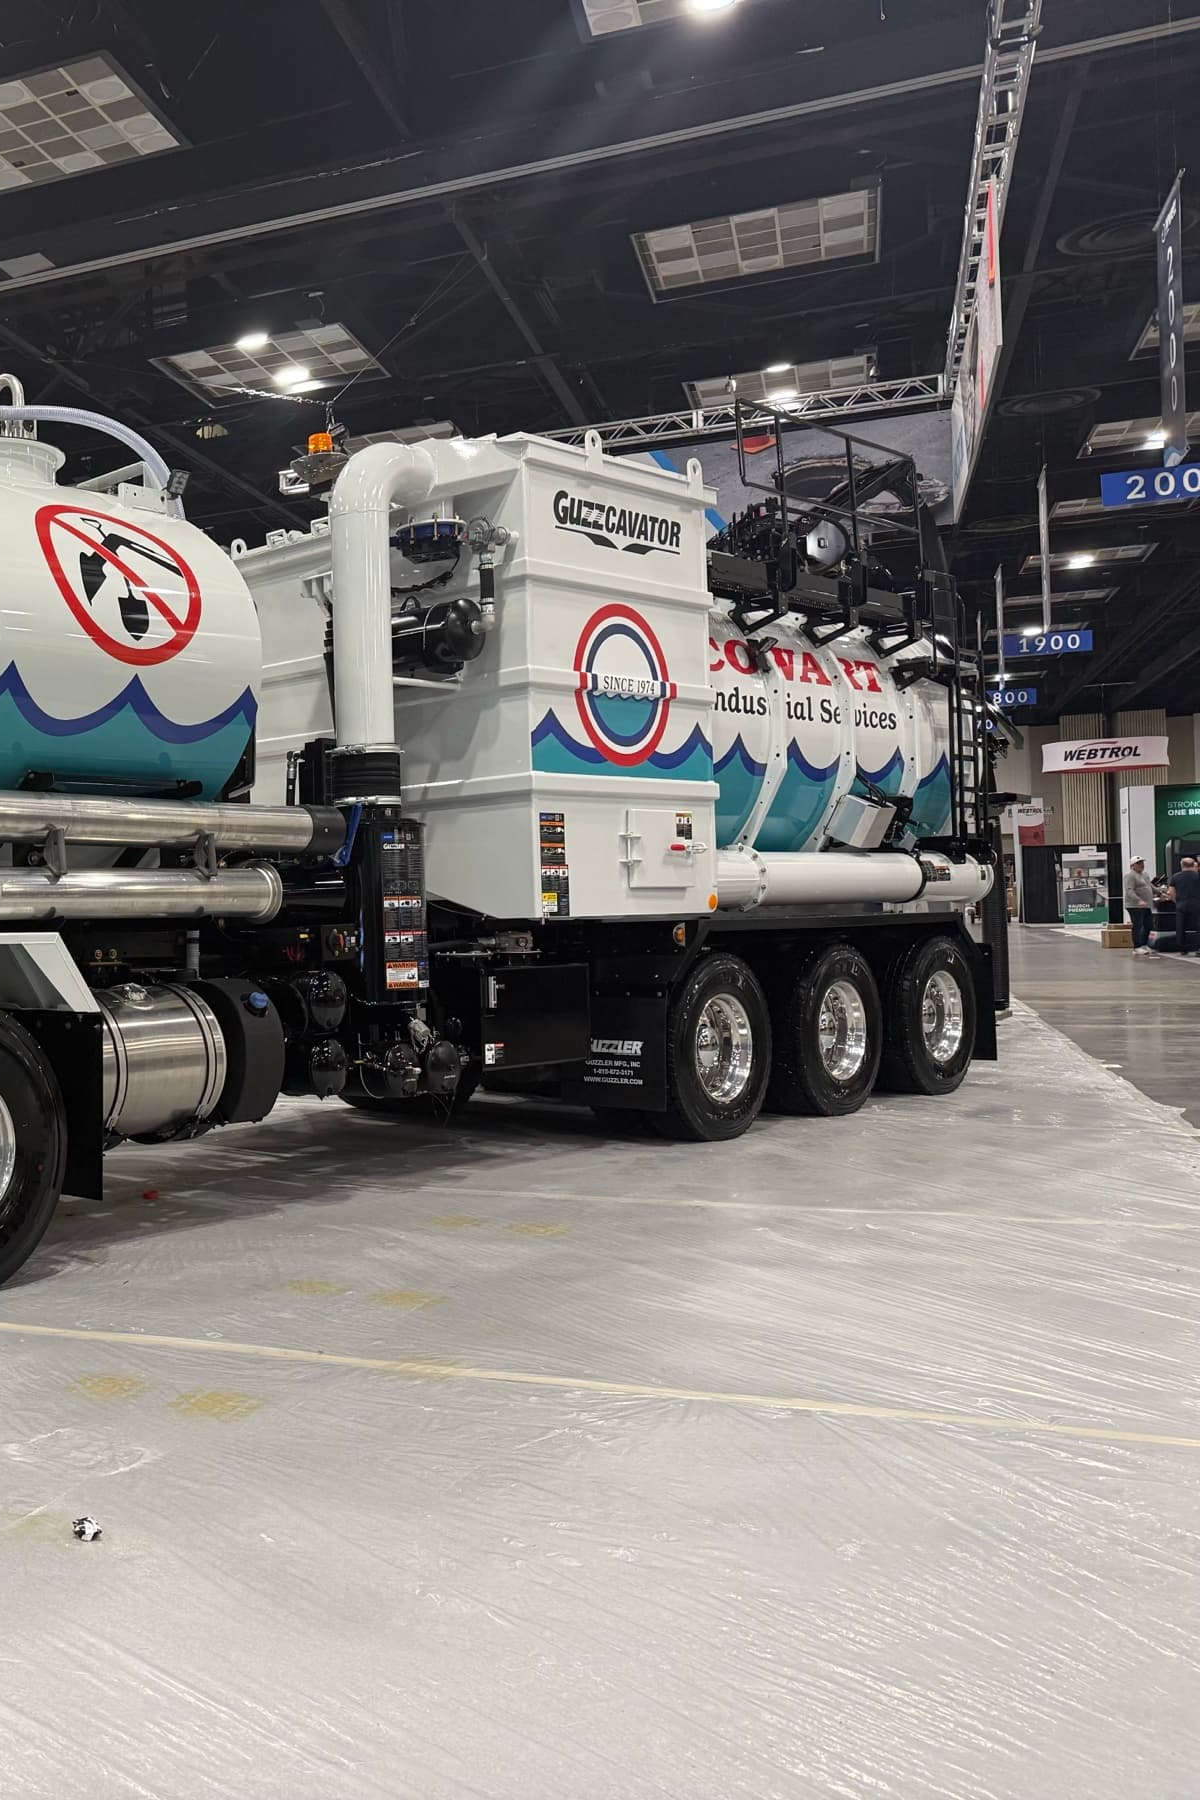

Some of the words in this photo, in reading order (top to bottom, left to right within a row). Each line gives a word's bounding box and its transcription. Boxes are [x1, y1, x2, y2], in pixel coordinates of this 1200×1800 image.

[1019, 633, 1081, 653] 1900
[603, 675, 634, 692] SINCE
[637, 680, 655, 695] 1974
[1064, 745, 1141, 762] WEBTROL
